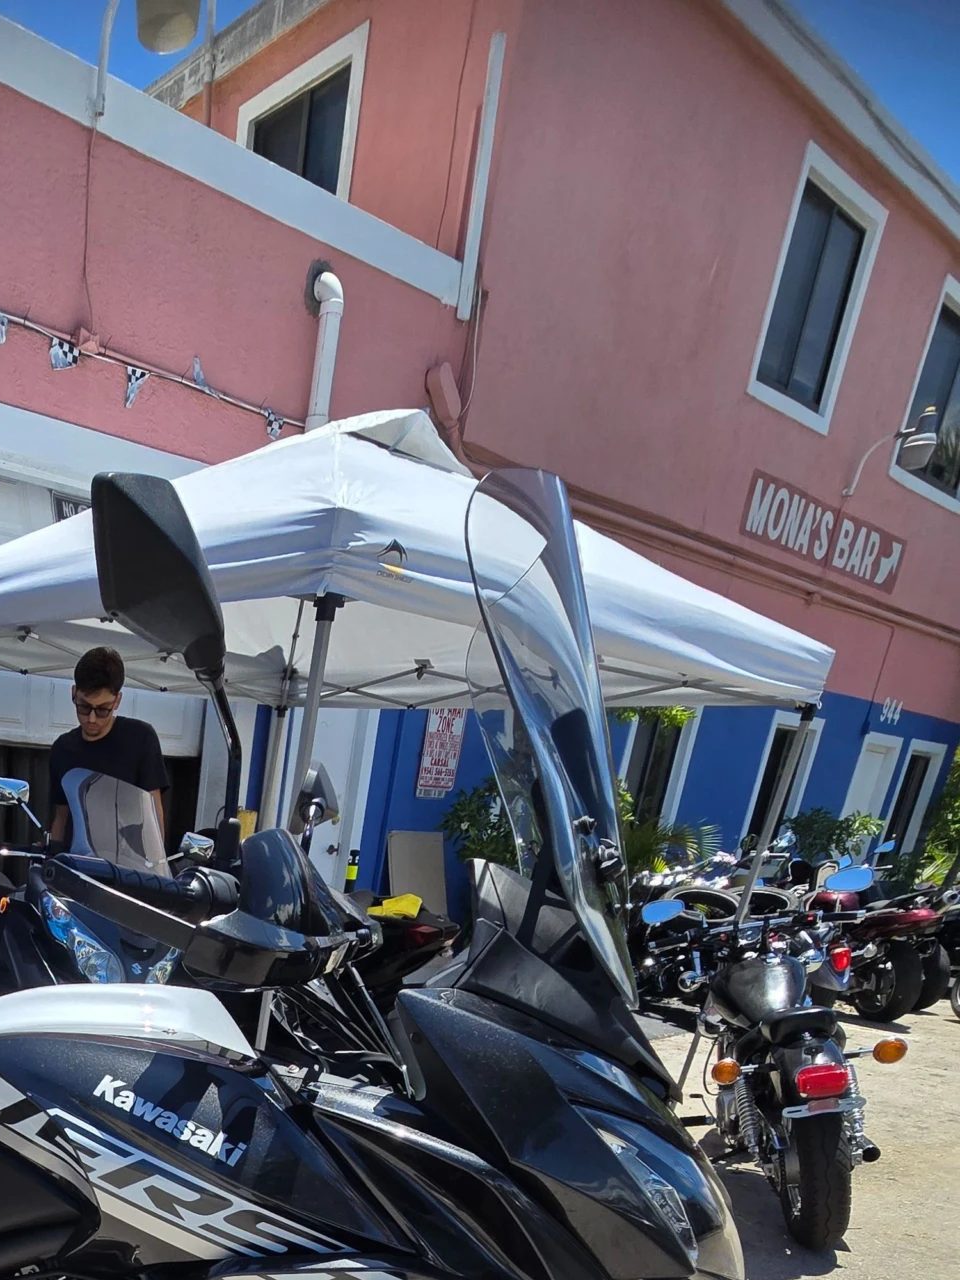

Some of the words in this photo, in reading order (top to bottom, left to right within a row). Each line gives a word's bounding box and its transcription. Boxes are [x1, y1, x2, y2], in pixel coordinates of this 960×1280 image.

[62, 501, 76, 518] NO
[745, 478, 834, 561] MONA'S
[832, 518, 881, 579] BAR
[437, 716, 455, 734] ZONE
[880, 697, 903, 725] 944
[92, 1073, 248, 1168] Kawasaki
